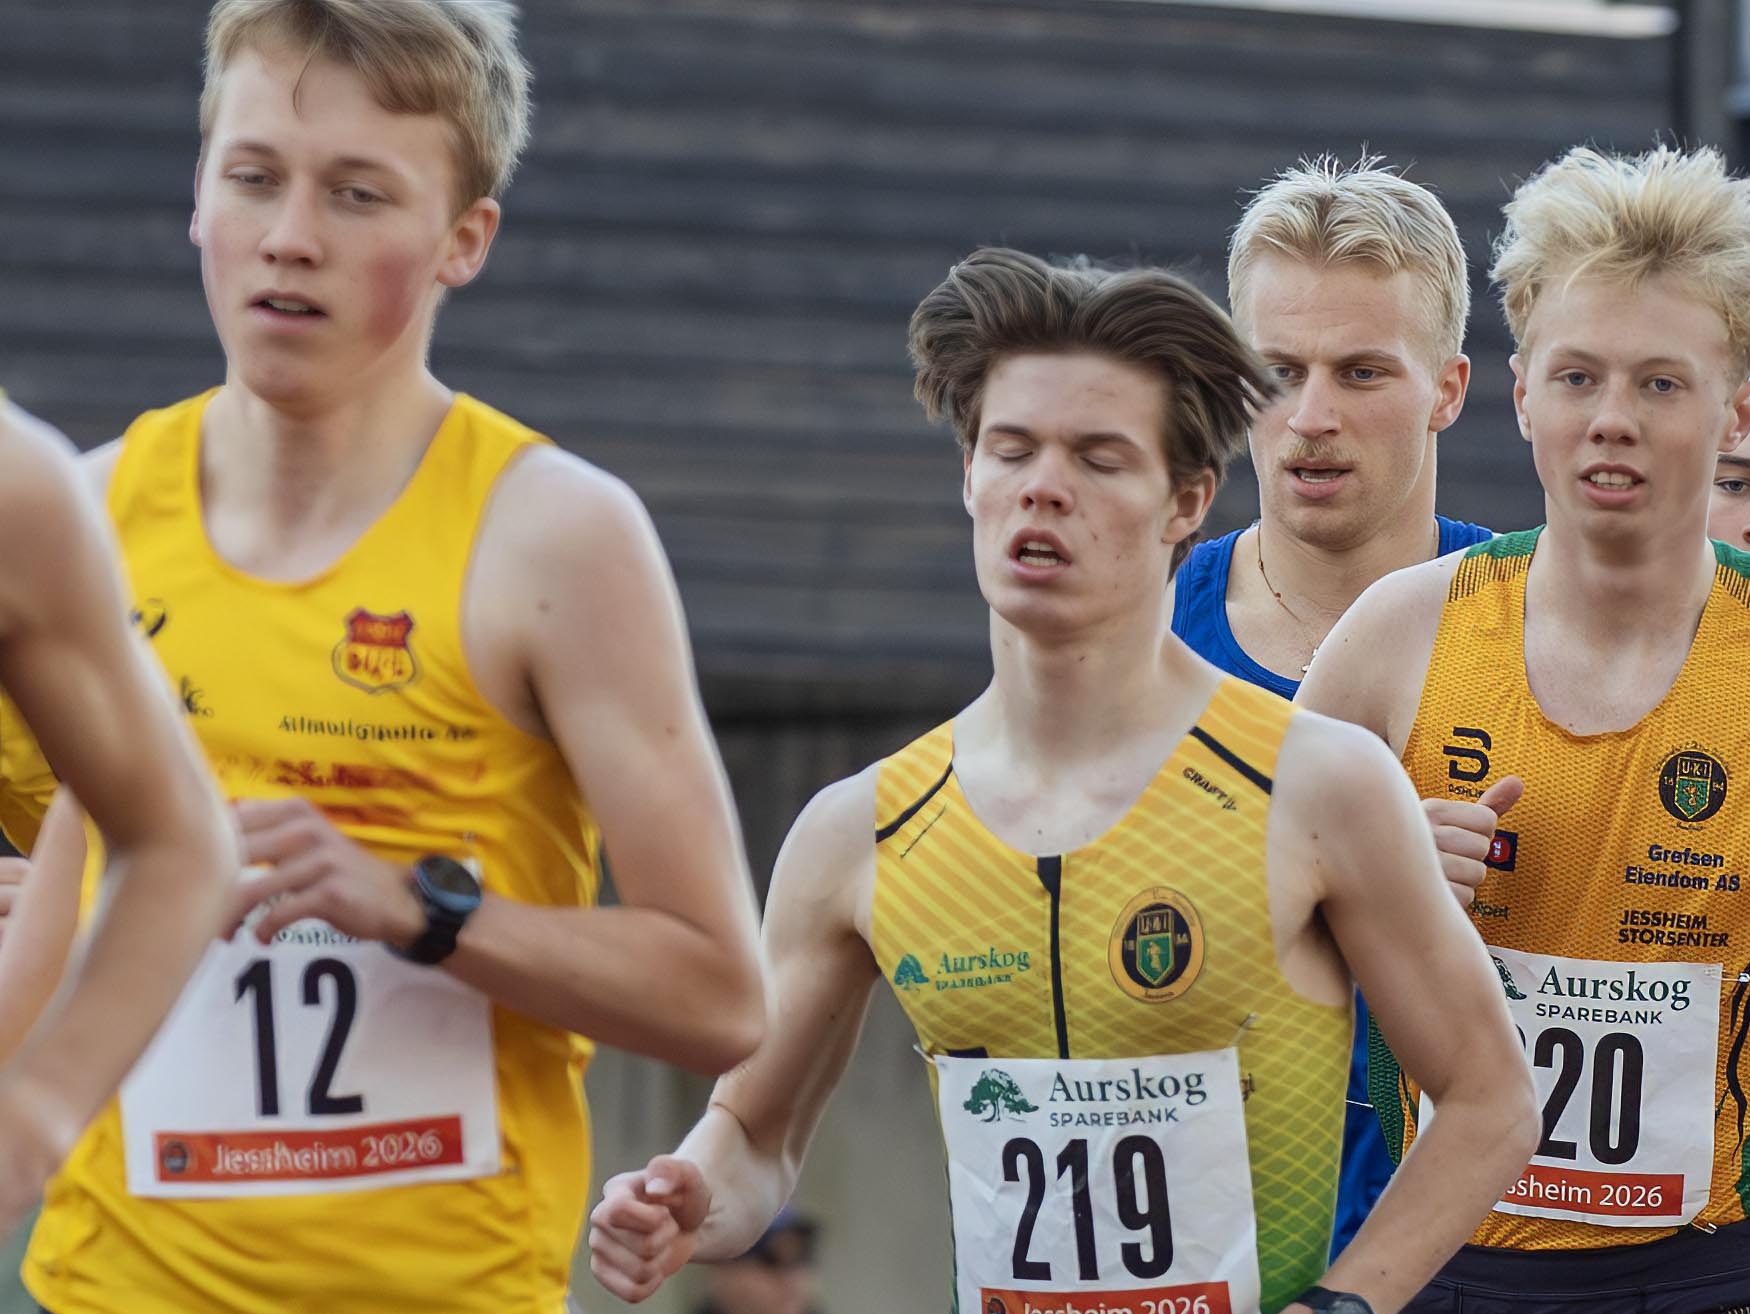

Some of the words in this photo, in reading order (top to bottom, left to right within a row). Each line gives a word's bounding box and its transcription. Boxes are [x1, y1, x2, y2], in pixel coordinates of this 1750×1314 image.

[1648, 844, 1724, 868] Grefsen
[1625, 866, 1709, 890] Eiendom
[1714, 875, 1741, 892] AS
[1619, 909, 1708, 930] JESSHEIM
[1618, 928, 1729, 948] STORSENTER
[1537, 965, 1691, 1010] Aurskog
[1536, 1003, 1663, 1024] SPAREBANK
[234, 958, 363, 1117] 12
[1049, 1068, 1207, 1105] Aurskog
[1516, 1024, 1643, 1165] 20
[1050, 1107, 1179, 1127] SPAREBANK
[361, 1128, 443, 1163] 2026
[1002, 1135, 1174, 1281] 219
[1506, 1174, 1591, 1204] sheim
[1599, 1184, 1663, 1208] 2026
